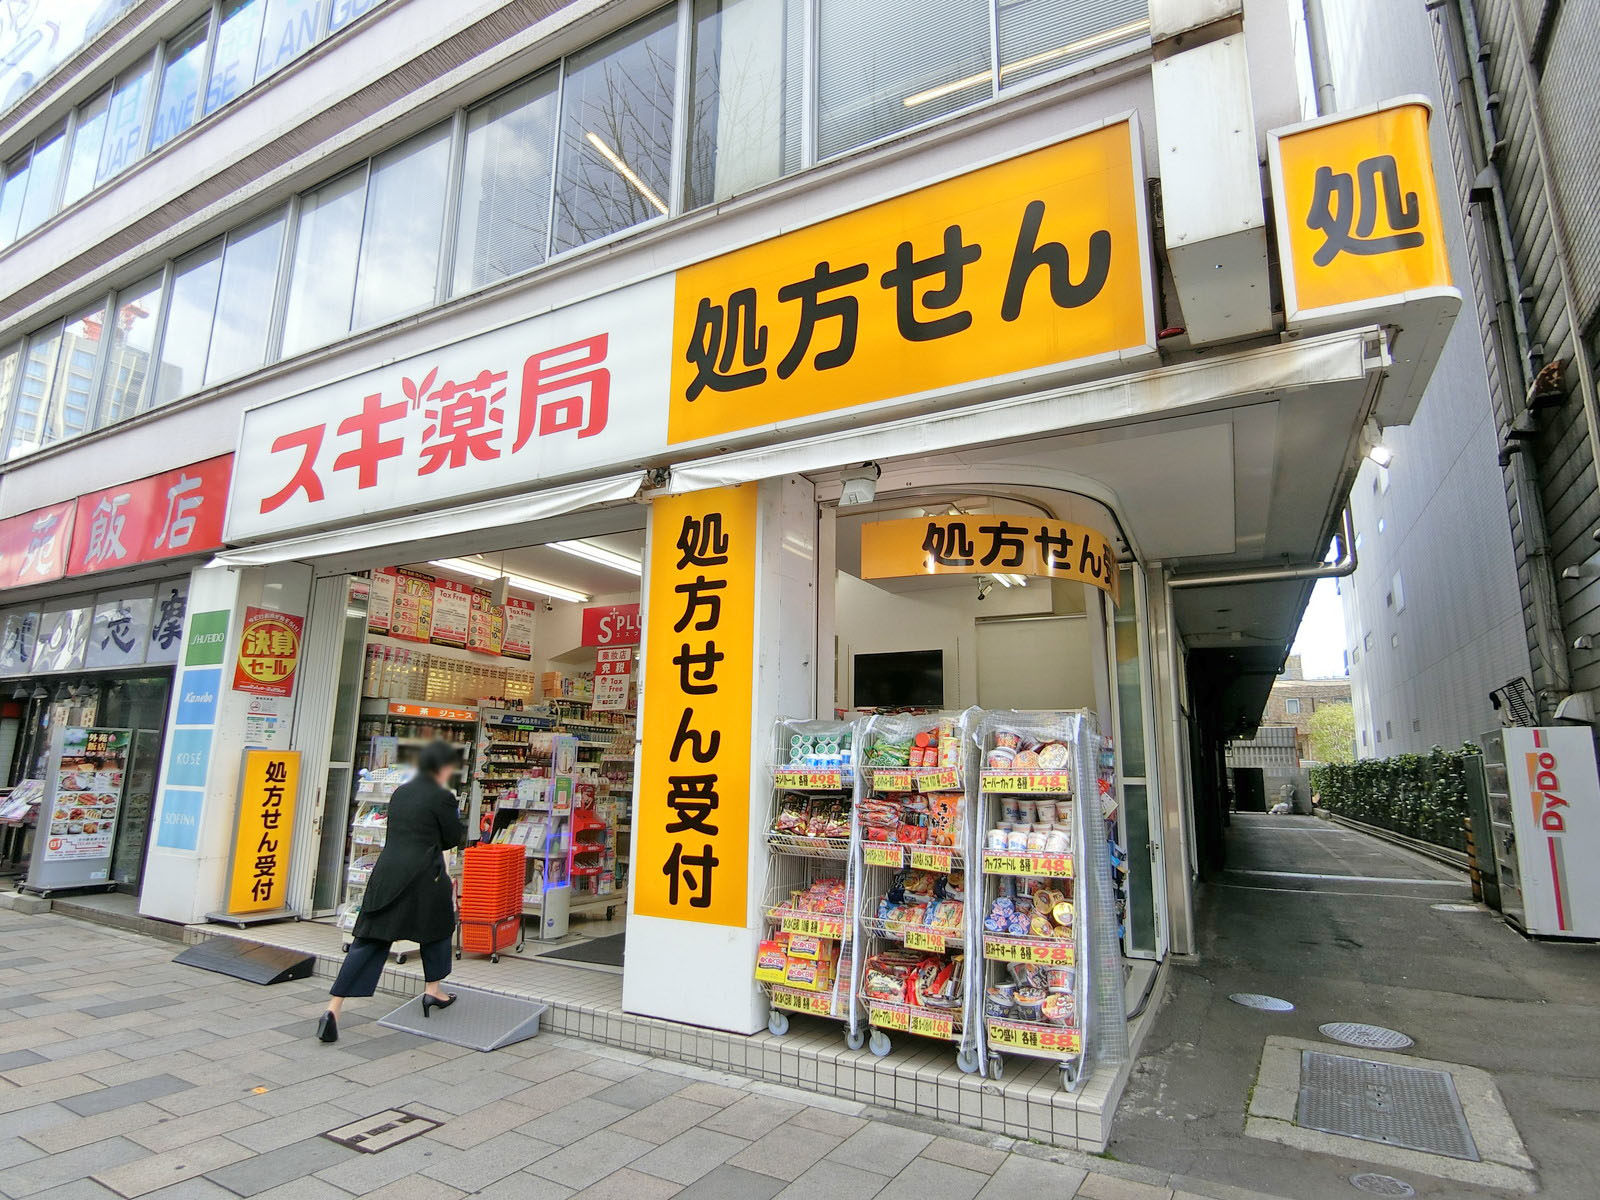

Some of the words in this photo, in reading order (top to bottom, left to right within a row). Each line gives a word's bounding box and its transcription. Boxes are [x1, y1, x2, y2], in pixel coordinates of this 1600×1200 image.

[1306, 155, 1424, 267] 処
[686, 200, 1111, 402] 処方せん
[260, 333, 610, 514] スギ薬局
[0, 473, 204, 581] 苑飯店
[440, 590, 452, 599] Tax
[453, 592, 467, 603] Free
[247, 630, 294, 656] 決算
[248, 659, 288, 676] セール
[184, 692, 213, 704] Kanebo
[609, 685, 624, 693] Free
[440, 710, 473, 719] ジュース
[662, 513, 729, 908] 処方せん受付
[982, 777, 1013, 789] スーパーカップ
[1536, 752, 1568, 831] DyDo
[165, 814, 195, 825] SOFINA
[251, 761, 287, 902] 処方せん受付
[985, 857, 1016, 871] カップヌードル
[985, 943, 1016, 958] 飲み干す一杯
[990, 1026, 1017, 1043] ごつ盛り
[1022, 1032, 1037, 1046] 各種
